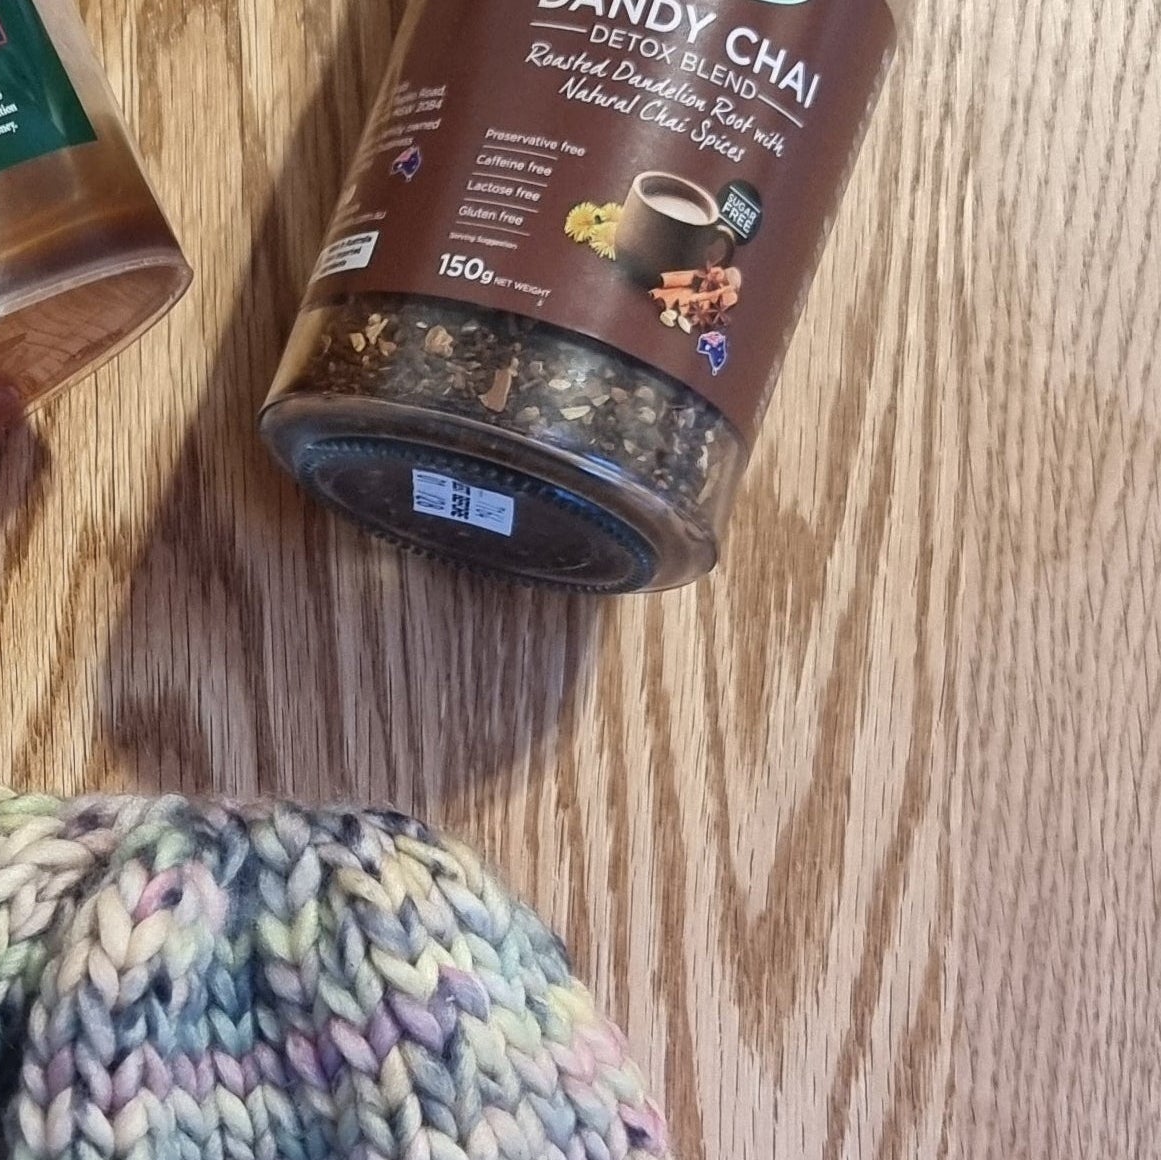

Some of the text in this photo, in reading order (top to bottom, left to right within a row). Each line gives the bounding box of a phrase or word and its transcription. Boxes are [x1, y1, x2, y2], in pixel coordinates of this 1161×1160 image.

[538, 0, 820, 109] NDY CHAI
[590, 25, 759, 101] DETOX BLEND
[524, 42, 785, 158] Roasted Dandelion Root with
[558, 76, 746, 163] Natural Chai Spices
[485, 128, 586, 157] Preservative free
[476, 154, 553, 177] Caffeine free
[466, 180, 541, 202] Lactose free
[458, 205, 524, 226] Gluten free
[722, 201, 751, 234] FREE
[727, 193, 757, 225] SUGAR
[438, 252, 552, 297] 150g NET WEIGHT
